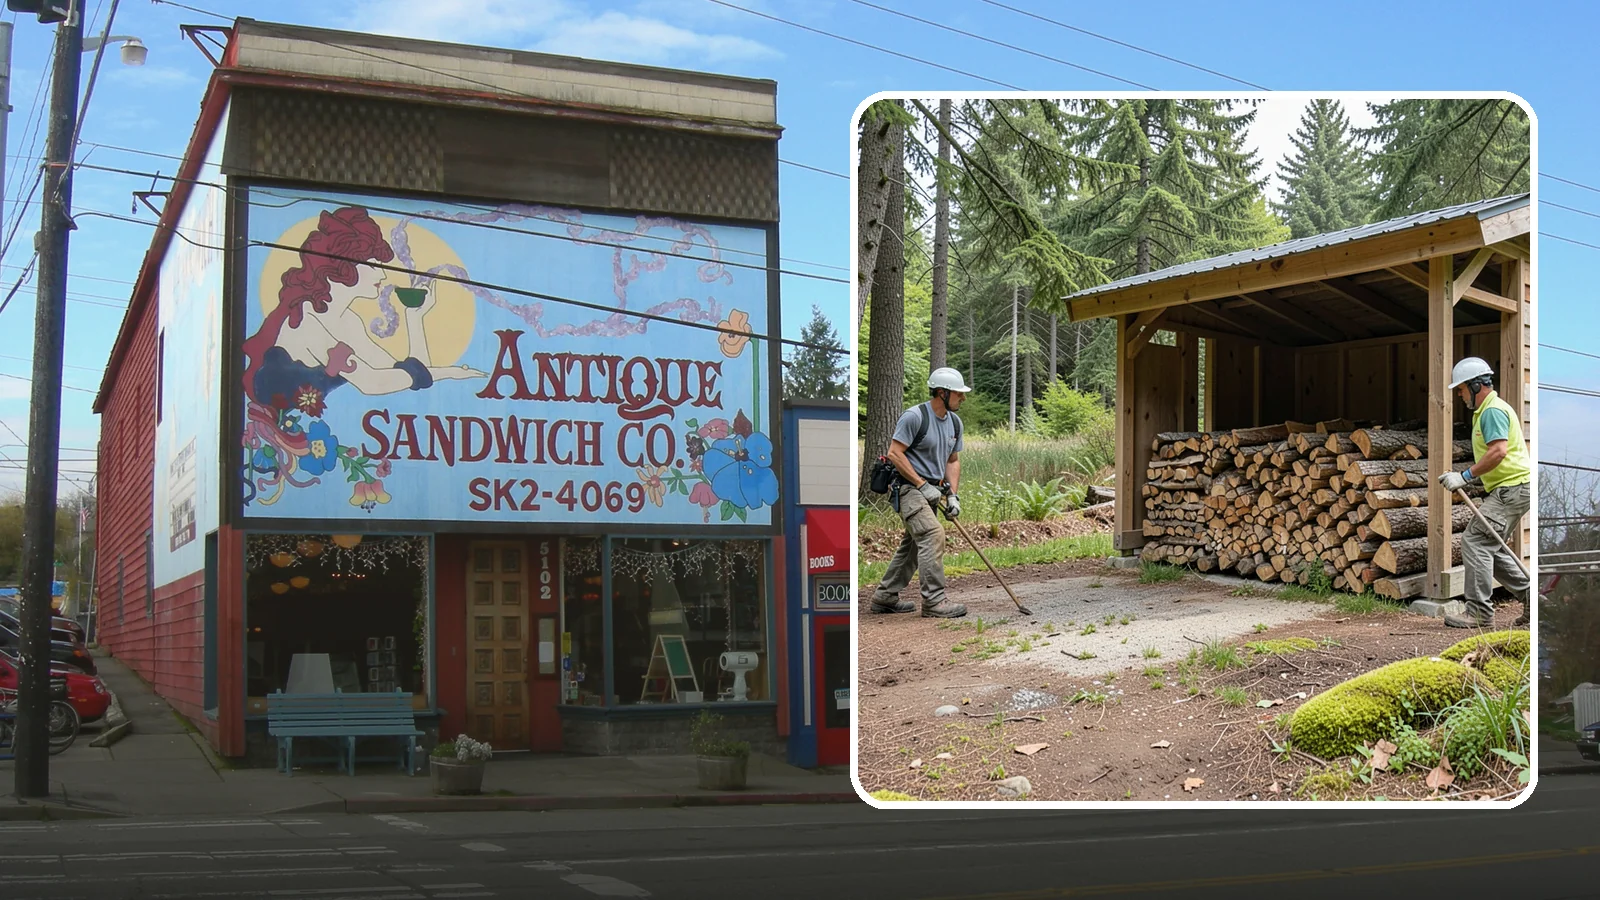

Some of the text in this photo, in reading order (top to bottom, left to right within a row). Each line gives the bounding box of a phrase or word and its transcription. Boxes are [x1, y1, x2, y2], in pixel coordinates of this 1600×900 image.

[475, 329, 723, 420] ANTIQUE
[361, 408, 685, 470] SANDWICH CO.
[468, 477, 645, 513] SK2-4069
[540, 541, 551, 600] 5102
[809, 555, 835, 569] BOOKS
